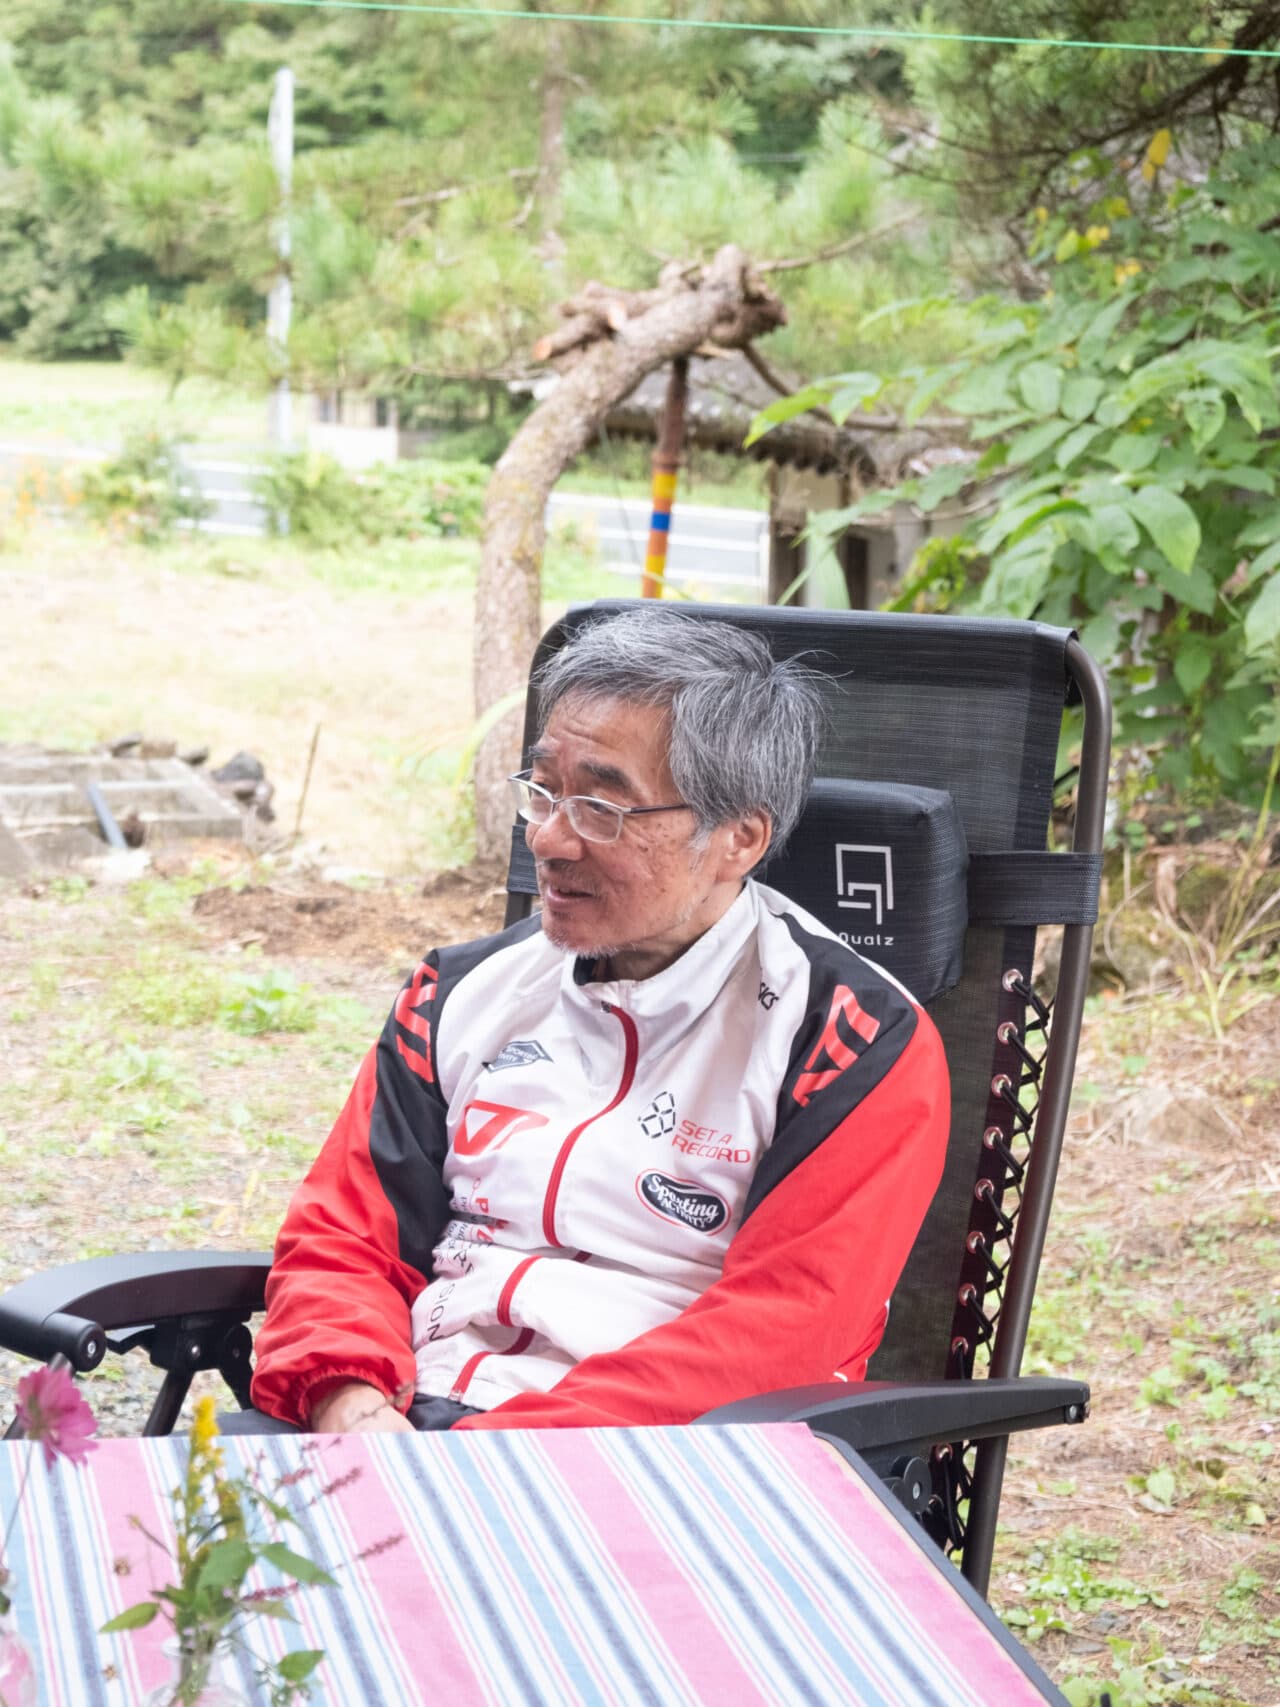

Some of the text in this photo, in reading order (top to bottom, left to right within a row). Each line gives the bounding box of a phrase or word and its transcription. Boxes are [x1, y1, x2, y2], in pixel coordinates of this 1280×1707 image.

[679, 1119, 733, 1145] SET A
[671, 1134, 751, 1163] RECORD
[647, 1174, 719, 1223] Sporting
